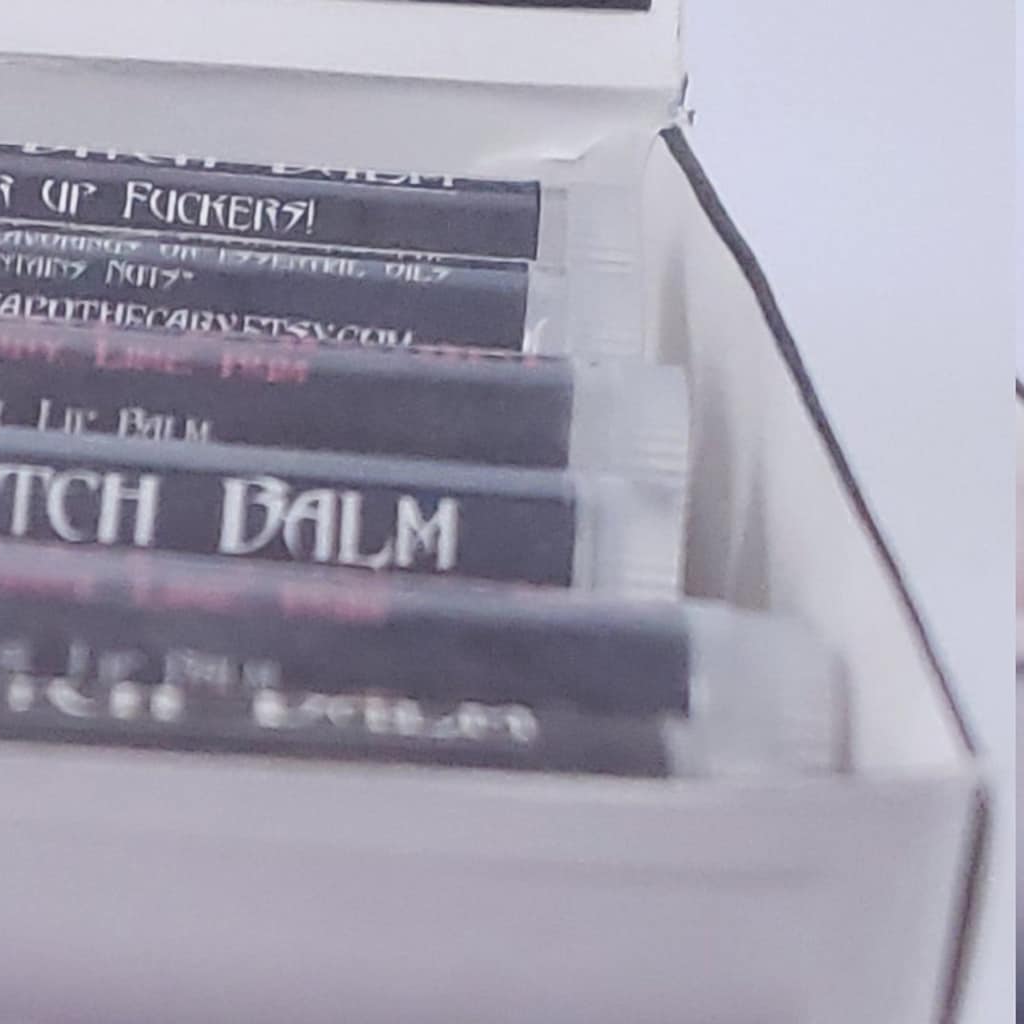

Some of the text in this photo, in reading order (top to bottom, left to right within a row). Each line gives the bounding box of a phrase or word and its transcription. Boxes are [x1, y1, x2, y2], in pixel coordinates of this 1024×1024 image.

[42, 179, 97, 217] UP
[122, 181, 316, 235] FUCKERS!
[218, 474, 461, 572] BALM
